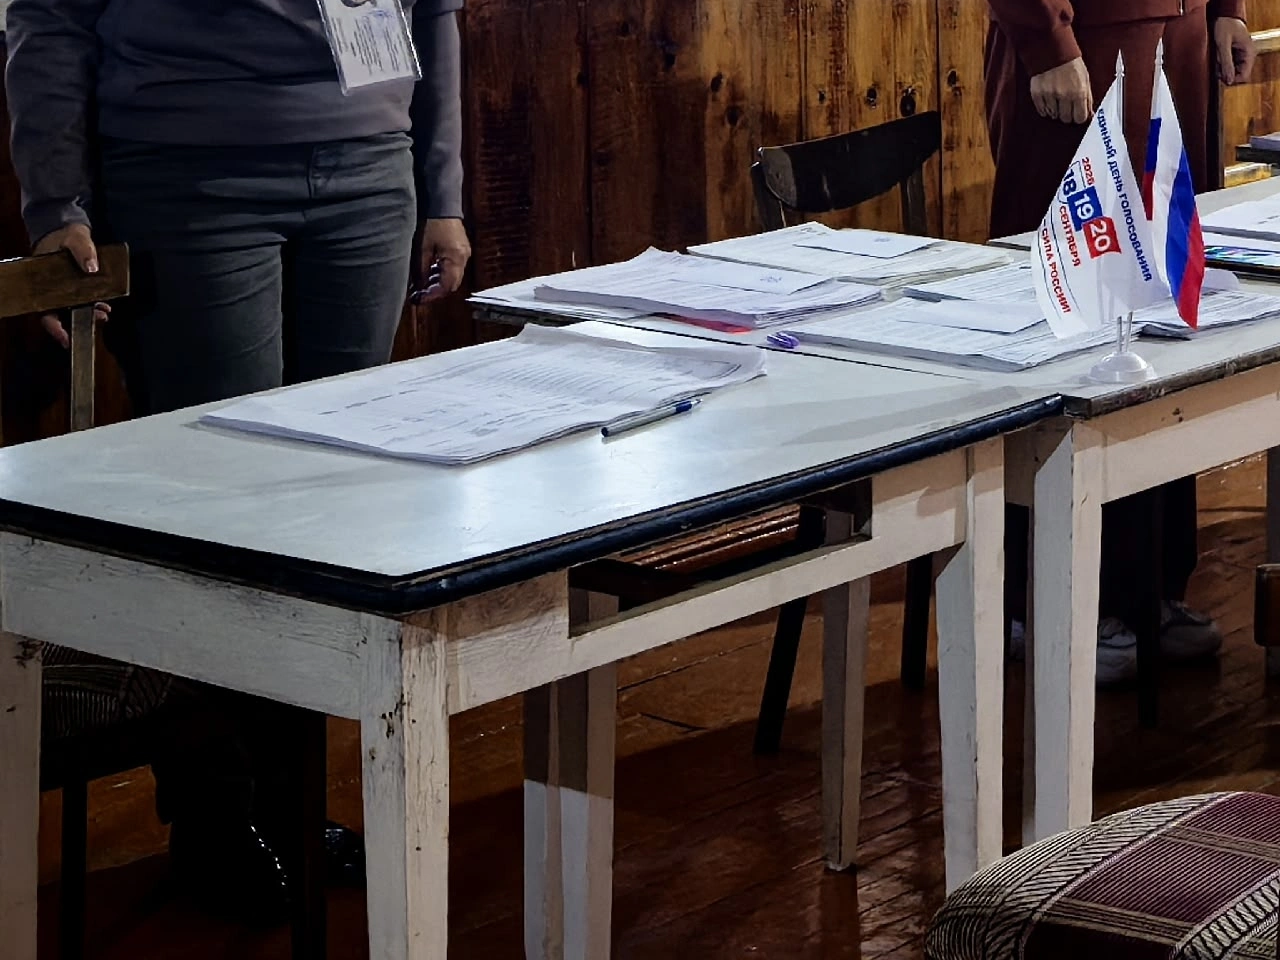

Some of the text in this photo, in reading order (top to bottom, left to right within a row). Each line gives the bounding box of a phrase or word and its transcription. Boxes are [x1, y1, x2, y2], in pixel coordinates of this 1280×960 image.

[1063, 168, 1111, 252] 18 19 20
[1097, 108, 1153, 282] ЕДИНЫЙ ДЕНЬ ГОЛОСОВАНИЯ
[1041, 227, 1054, 261] СИЛА
[1059, 205, 1081, 267] СЕНТЯБРЯ
